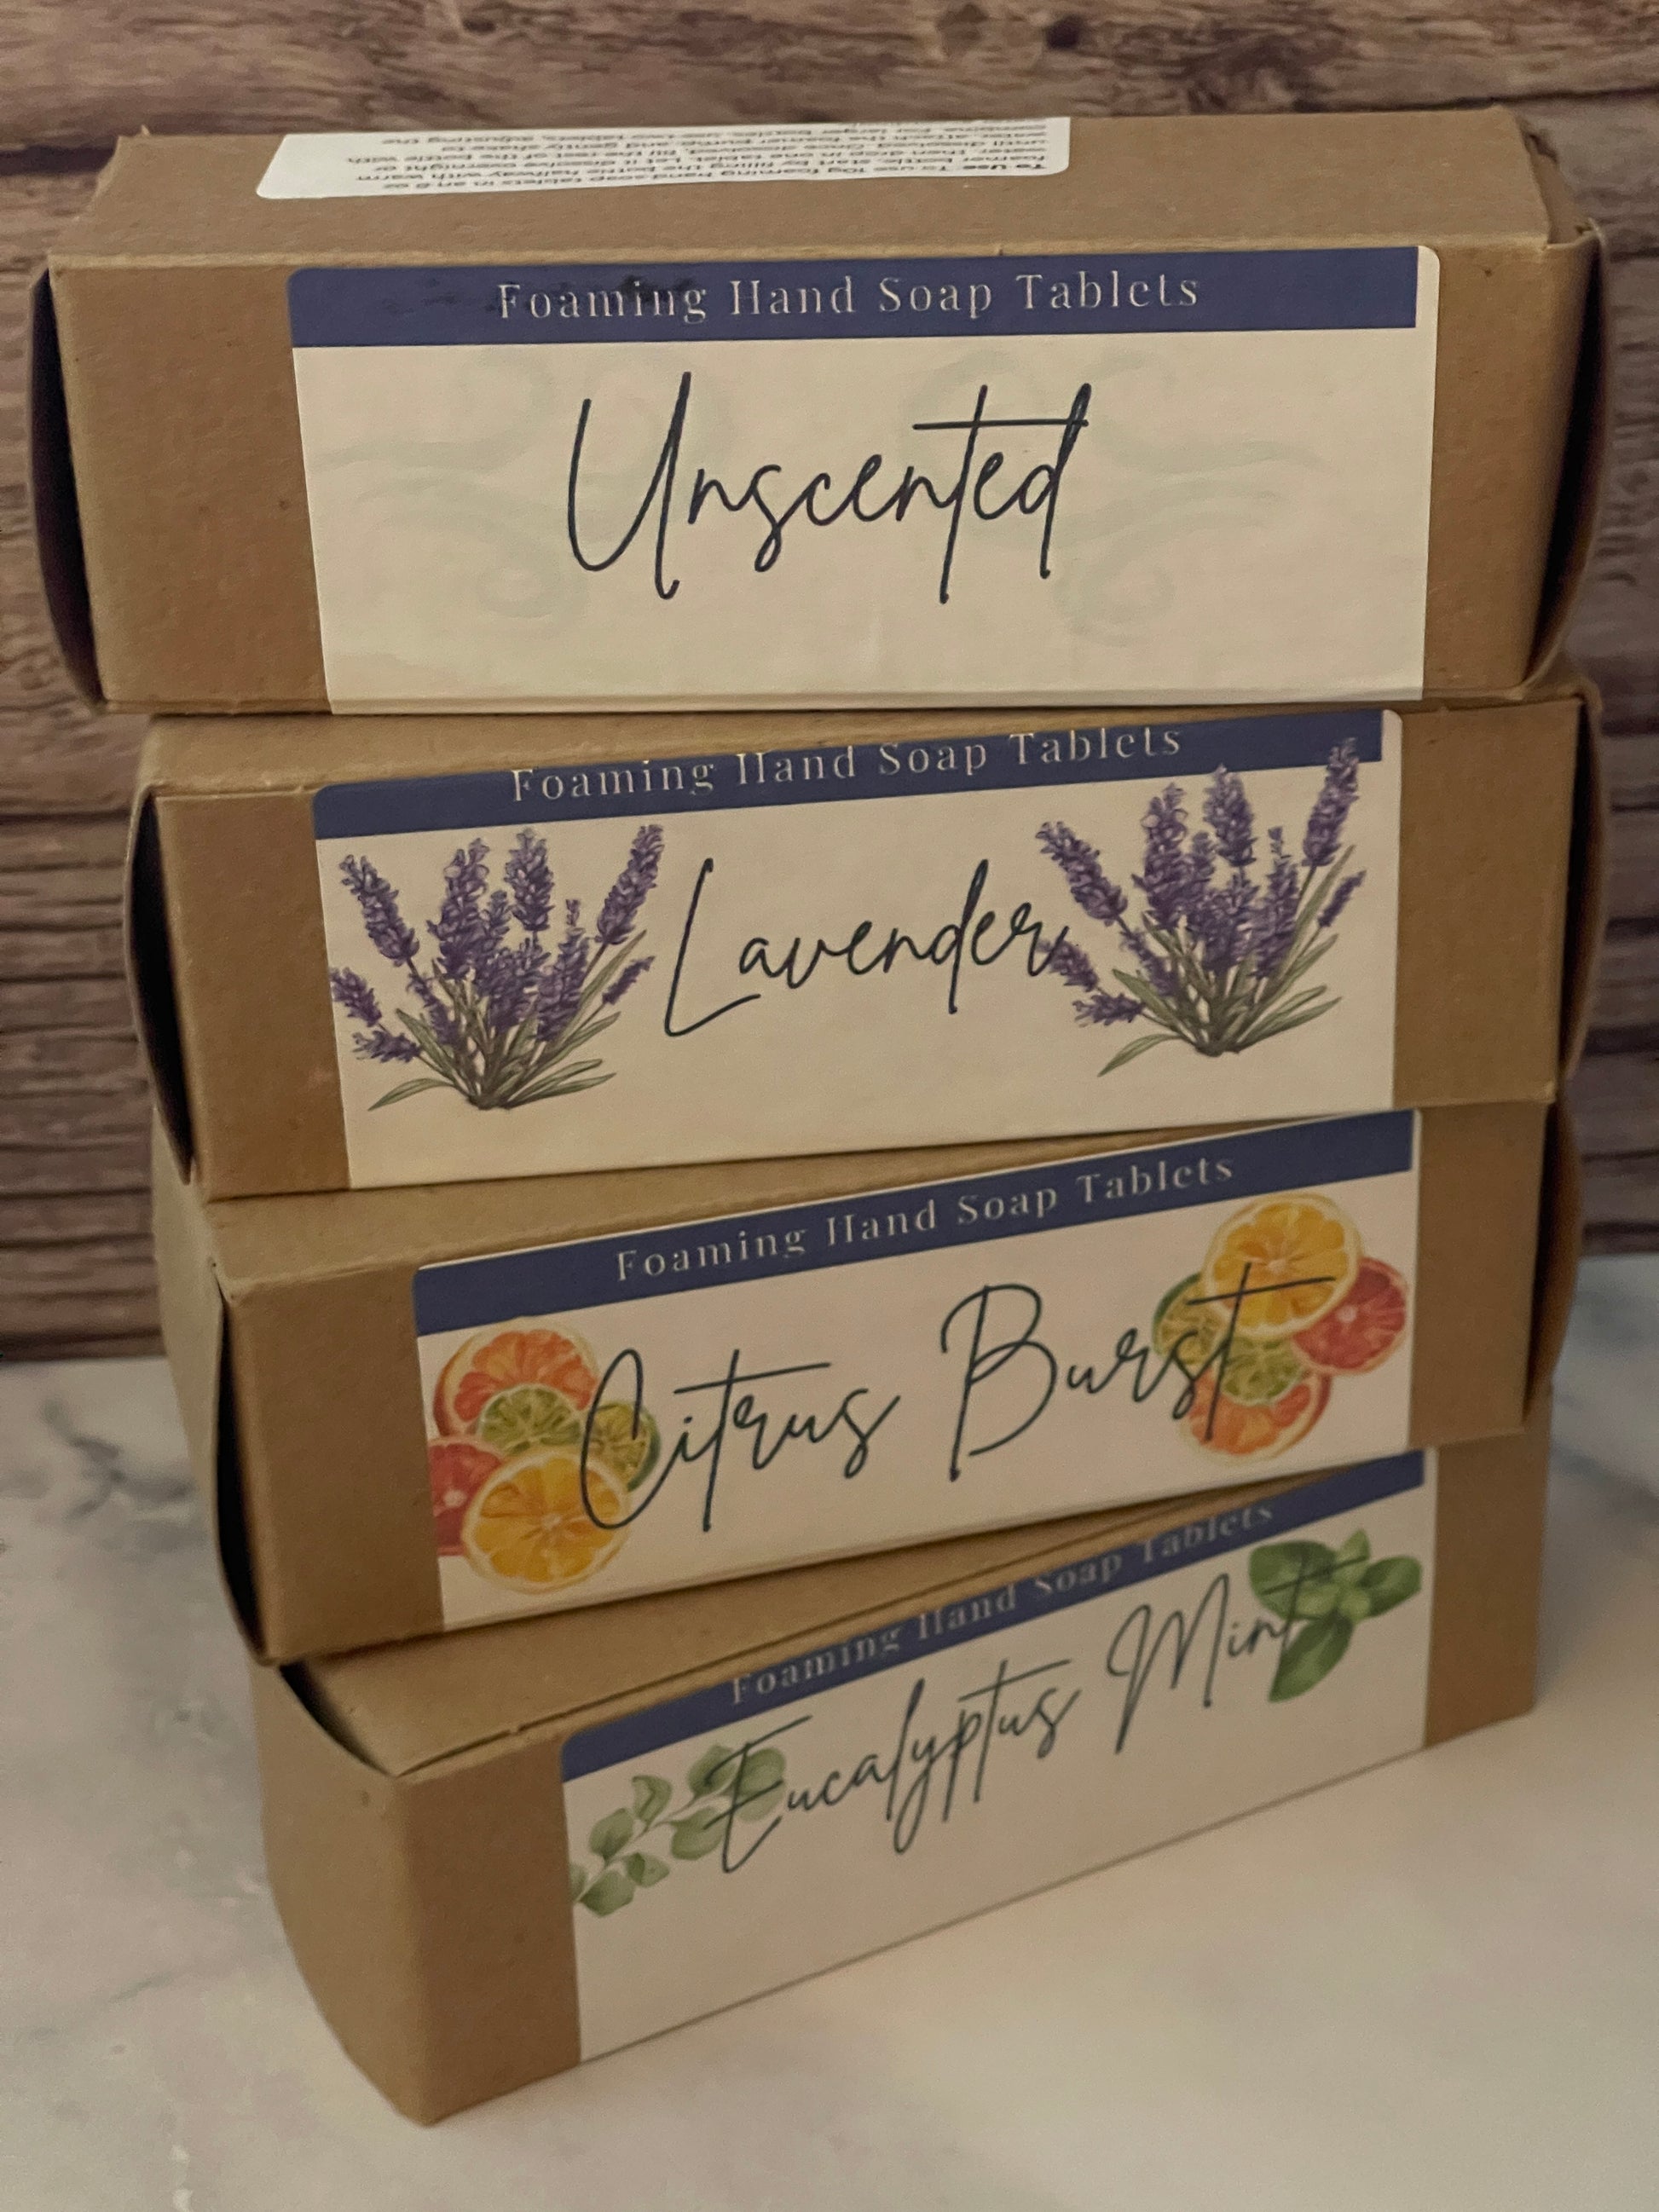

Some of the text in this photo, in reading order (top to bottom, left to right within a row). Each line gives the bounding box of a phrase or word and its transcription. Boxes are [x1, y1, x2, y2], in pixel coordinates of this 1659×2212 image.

[497, 270, 1200, 324] Foaming Hand Soap Tablets
[566, 370, 1091, 604] Unscented
[512, 727, 1182, 802] Foaming Hand Soap Tablets
[664, 858, 1069, 1037] Lavender
[616, 1158, 1234, 1281] Foaming Hand Soap Tablets
[579, 1262, 1337, 1533] Citrus Burst
[731, 1505, 1273, 1704] Foaming Hand Soap Tablets
[702, 1555, 1367, 1874] Eucalyptus Mint
